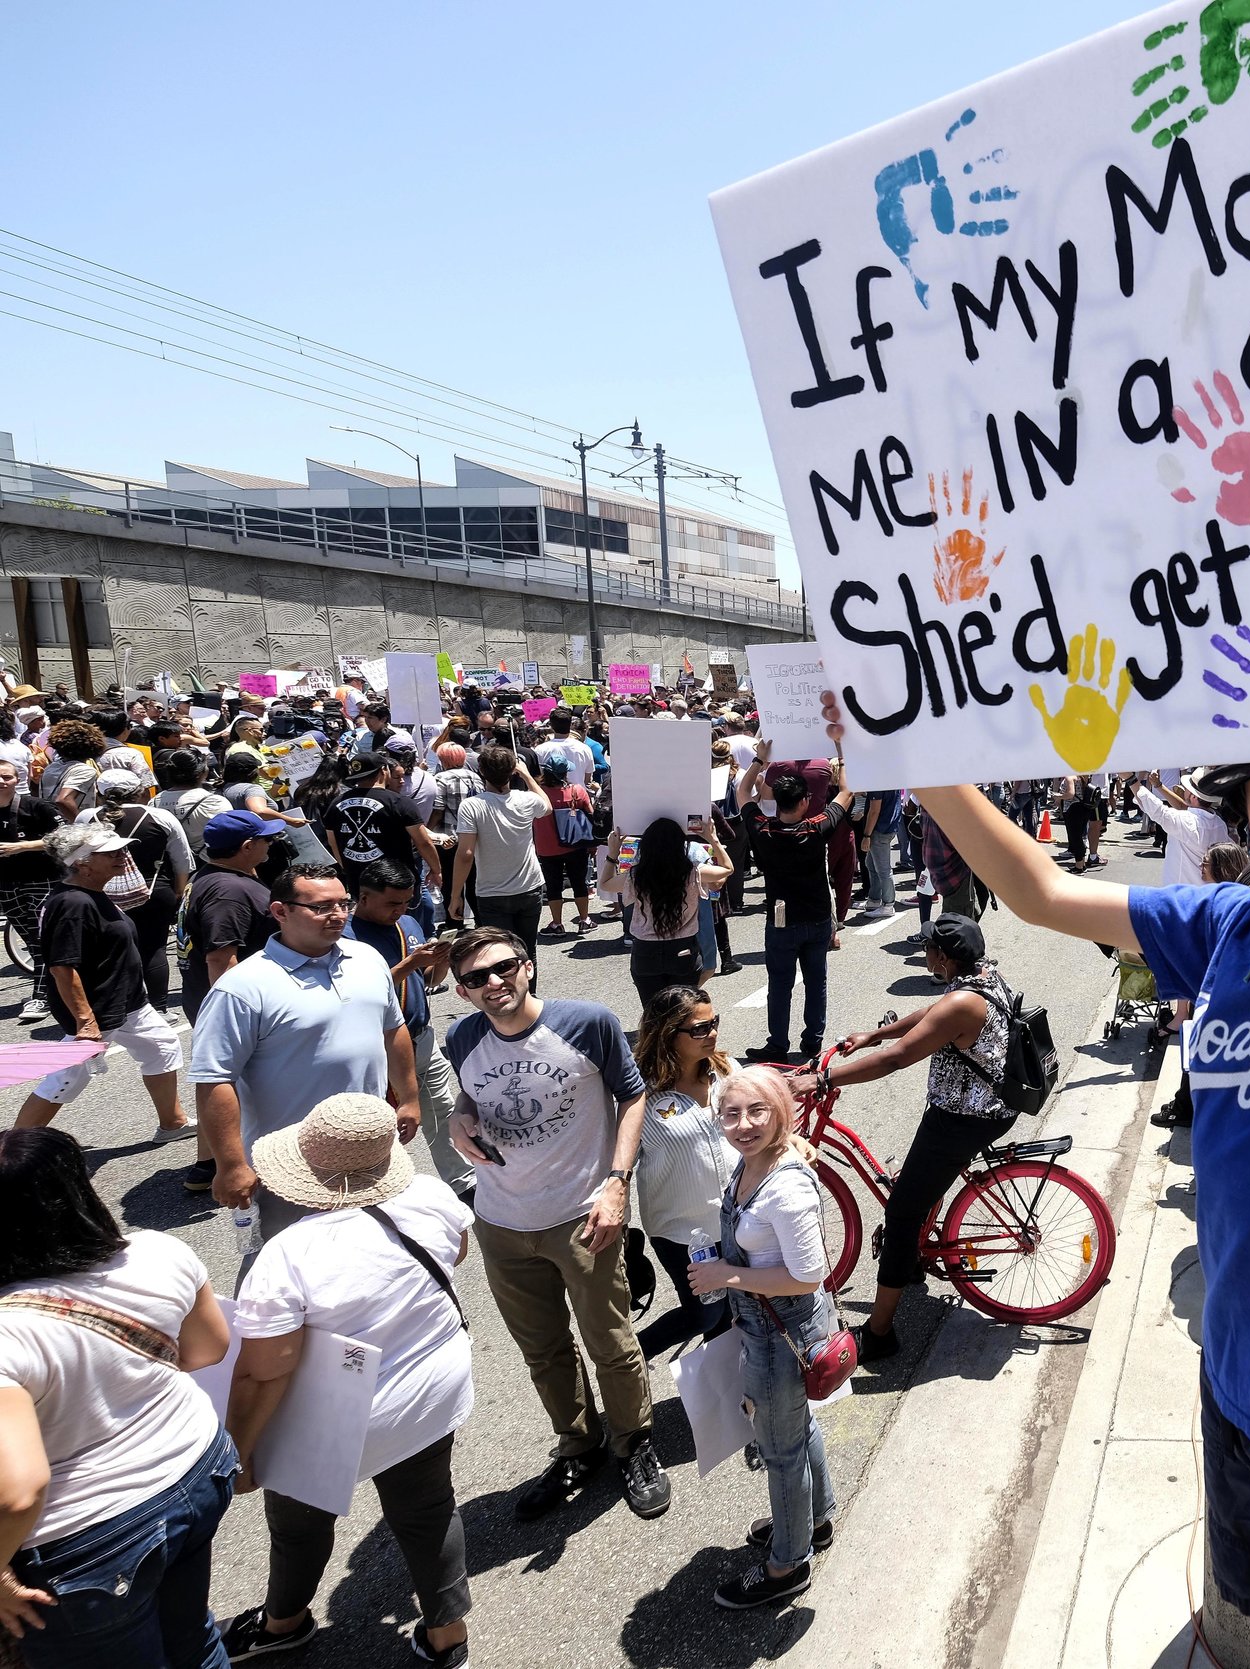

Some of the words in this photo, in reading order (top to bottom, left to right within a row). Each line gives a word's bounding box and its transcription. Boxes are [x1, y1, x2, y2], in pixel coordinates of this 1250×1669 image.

[760, 239, 893, 408] If
[987, 398, 1078, 514] IN
[1118, 357, 1180, 443] a
[830, 554, 1069, 736] She'd
[1125, 520, 1250, 701] get
[805, 698, 814, 706] A
[473, 1060, 570, 1097] ANCHOR
[544, 1084, 577, 1101] 1896
[502, 1111, 577, 1150] FRANCISCO
